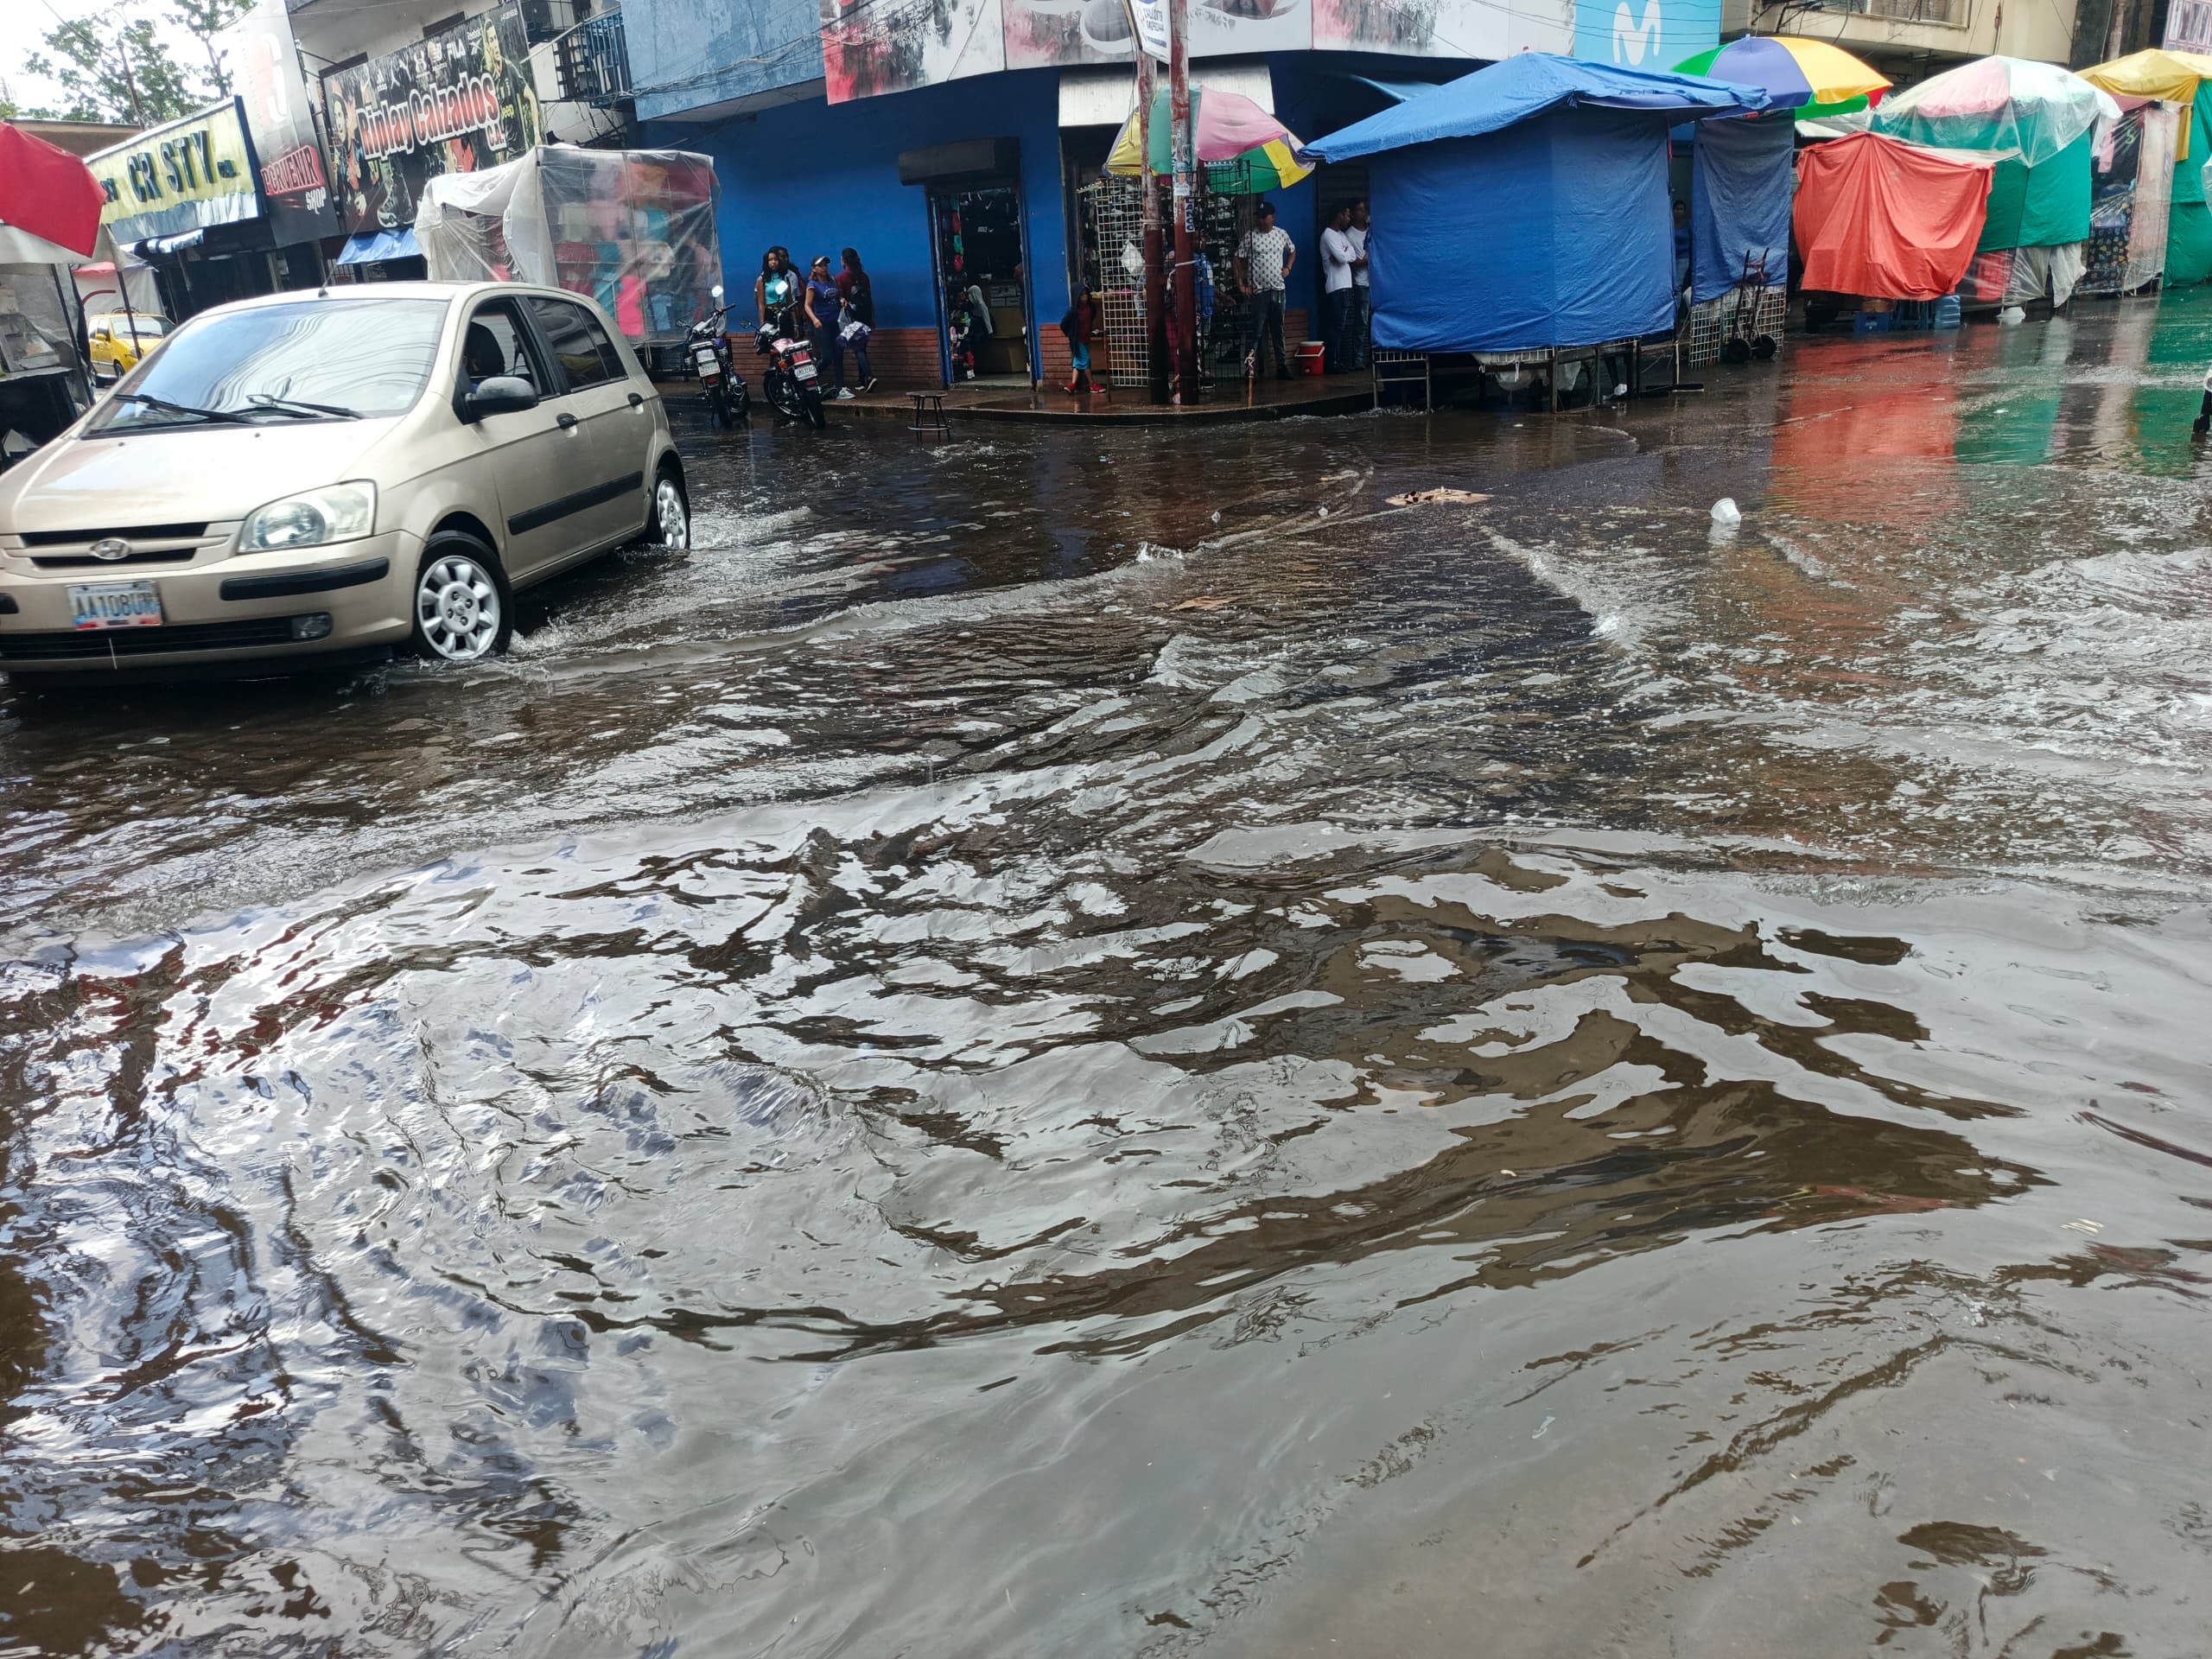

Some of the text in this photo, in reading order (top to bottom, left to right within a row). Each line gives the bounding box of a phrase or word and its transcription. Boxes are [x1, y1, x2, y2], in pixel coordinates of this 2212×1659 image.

[446, 39, 466, 61] FILA
[356, 72, 499, 161] Riplay Calzados
[261, 147, 320, 195] PORVENIR
[305, 186, 327, 214] SHOP
